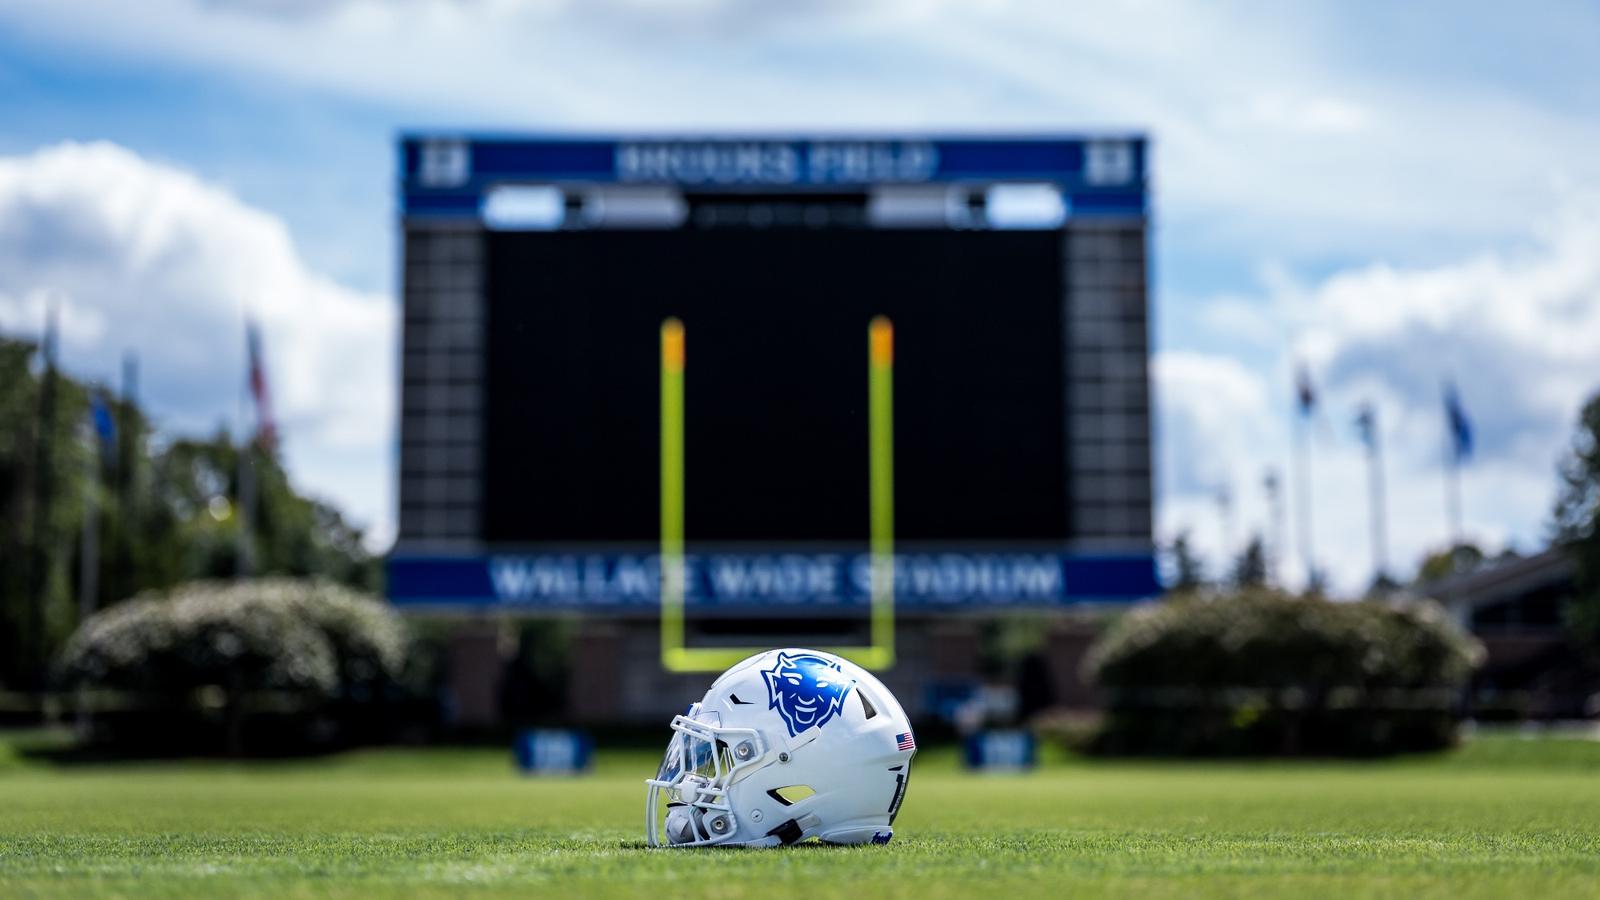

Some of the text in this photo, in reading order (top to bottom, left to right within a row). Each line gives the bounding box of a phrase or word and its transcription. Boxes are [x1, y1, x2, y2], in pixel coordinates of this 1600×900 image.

[617, 142, 938, 184] BROOKS FIELD
[707, 554, 842, 603] WADE
